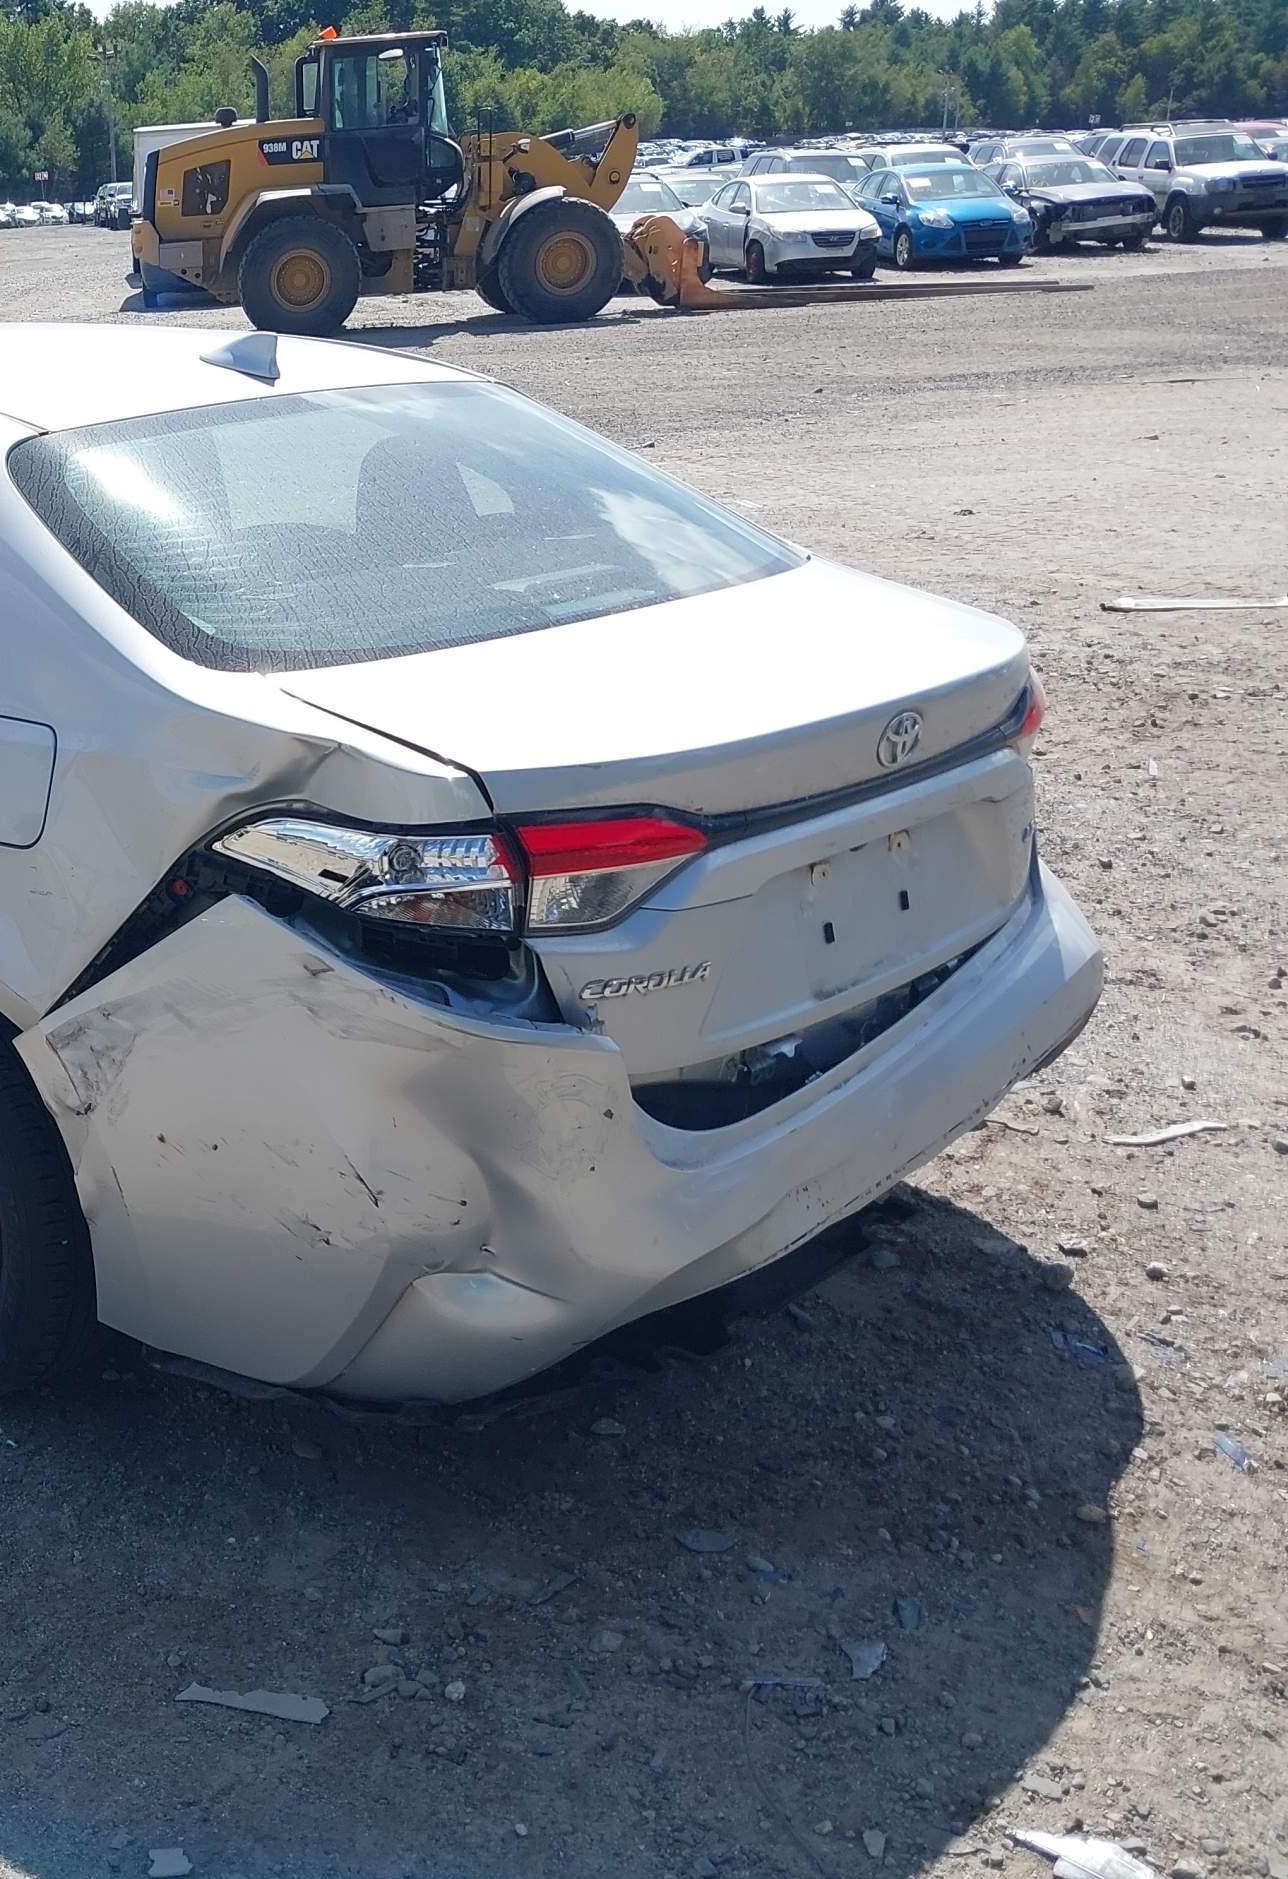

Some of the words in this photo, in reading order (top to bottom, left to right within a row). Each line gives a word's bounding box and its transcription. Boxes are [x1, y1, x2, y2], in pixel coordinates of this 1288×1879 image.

[263, 142, 287, 153] 938M
[292, 140, 320, 159] CAT
[579, 960, 712, 1000] COROLLA
